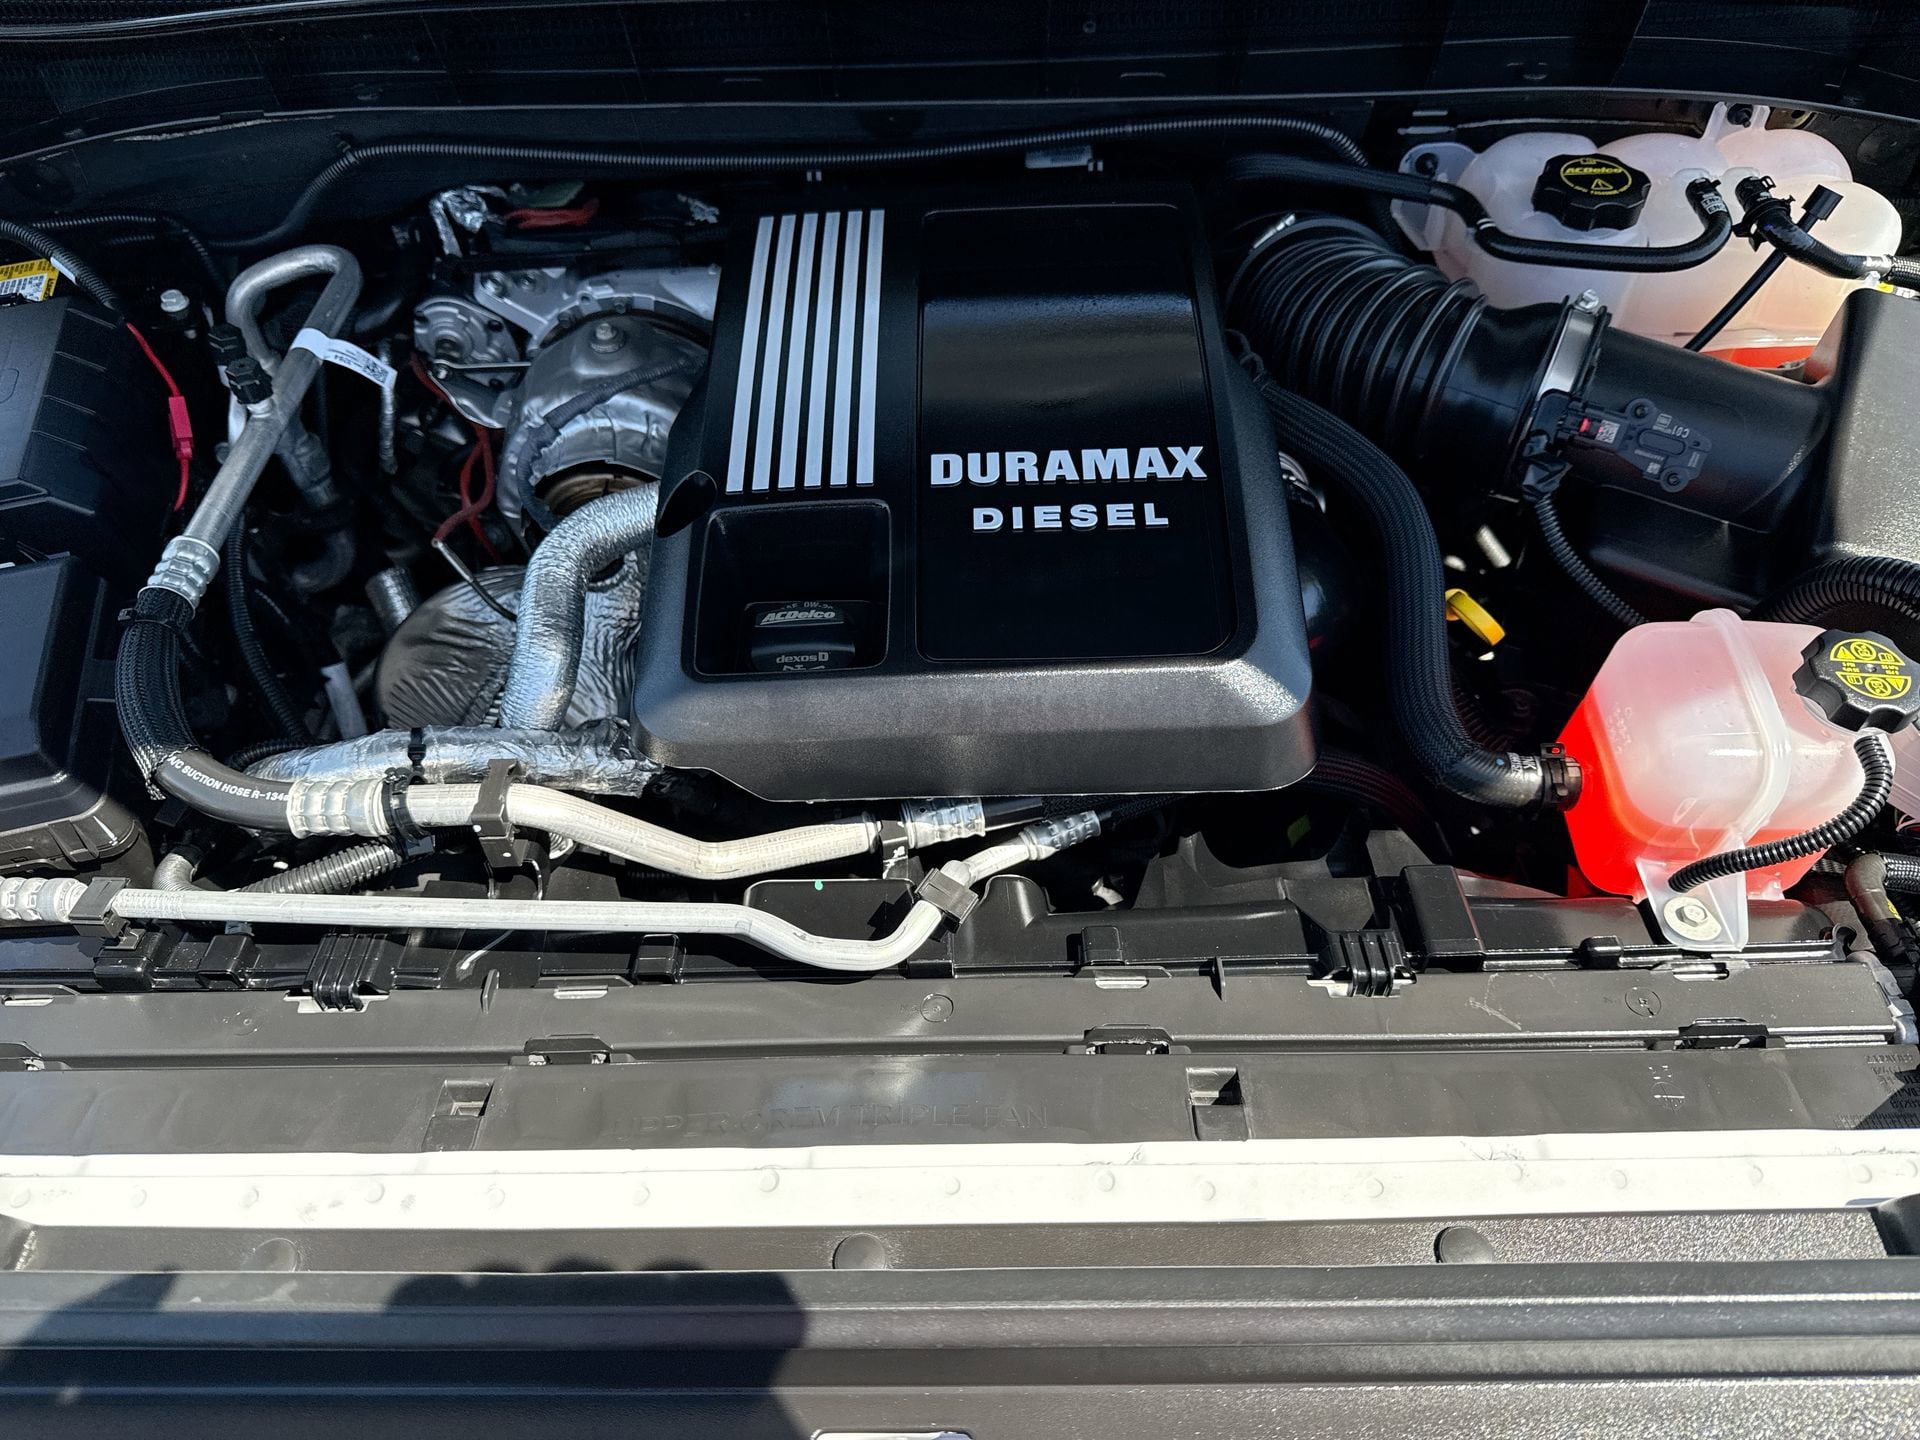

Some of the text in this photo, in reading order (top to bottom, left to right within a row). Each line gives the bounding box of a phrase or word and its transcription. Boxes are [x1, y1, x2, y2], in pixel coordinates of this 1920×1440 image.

[930, 446, 1208, 486] DURAMAX
[972, 503, 1170, 531] DIESEL
[760, 609, 836, 625] ACDelco
[181, 764, 223, 790] SUCTION
[220, 783, 252, 798] HOSE
[849, 1102, 973, 1128] TRIPLE
[983, 1103, 1050, 1129] FAN
